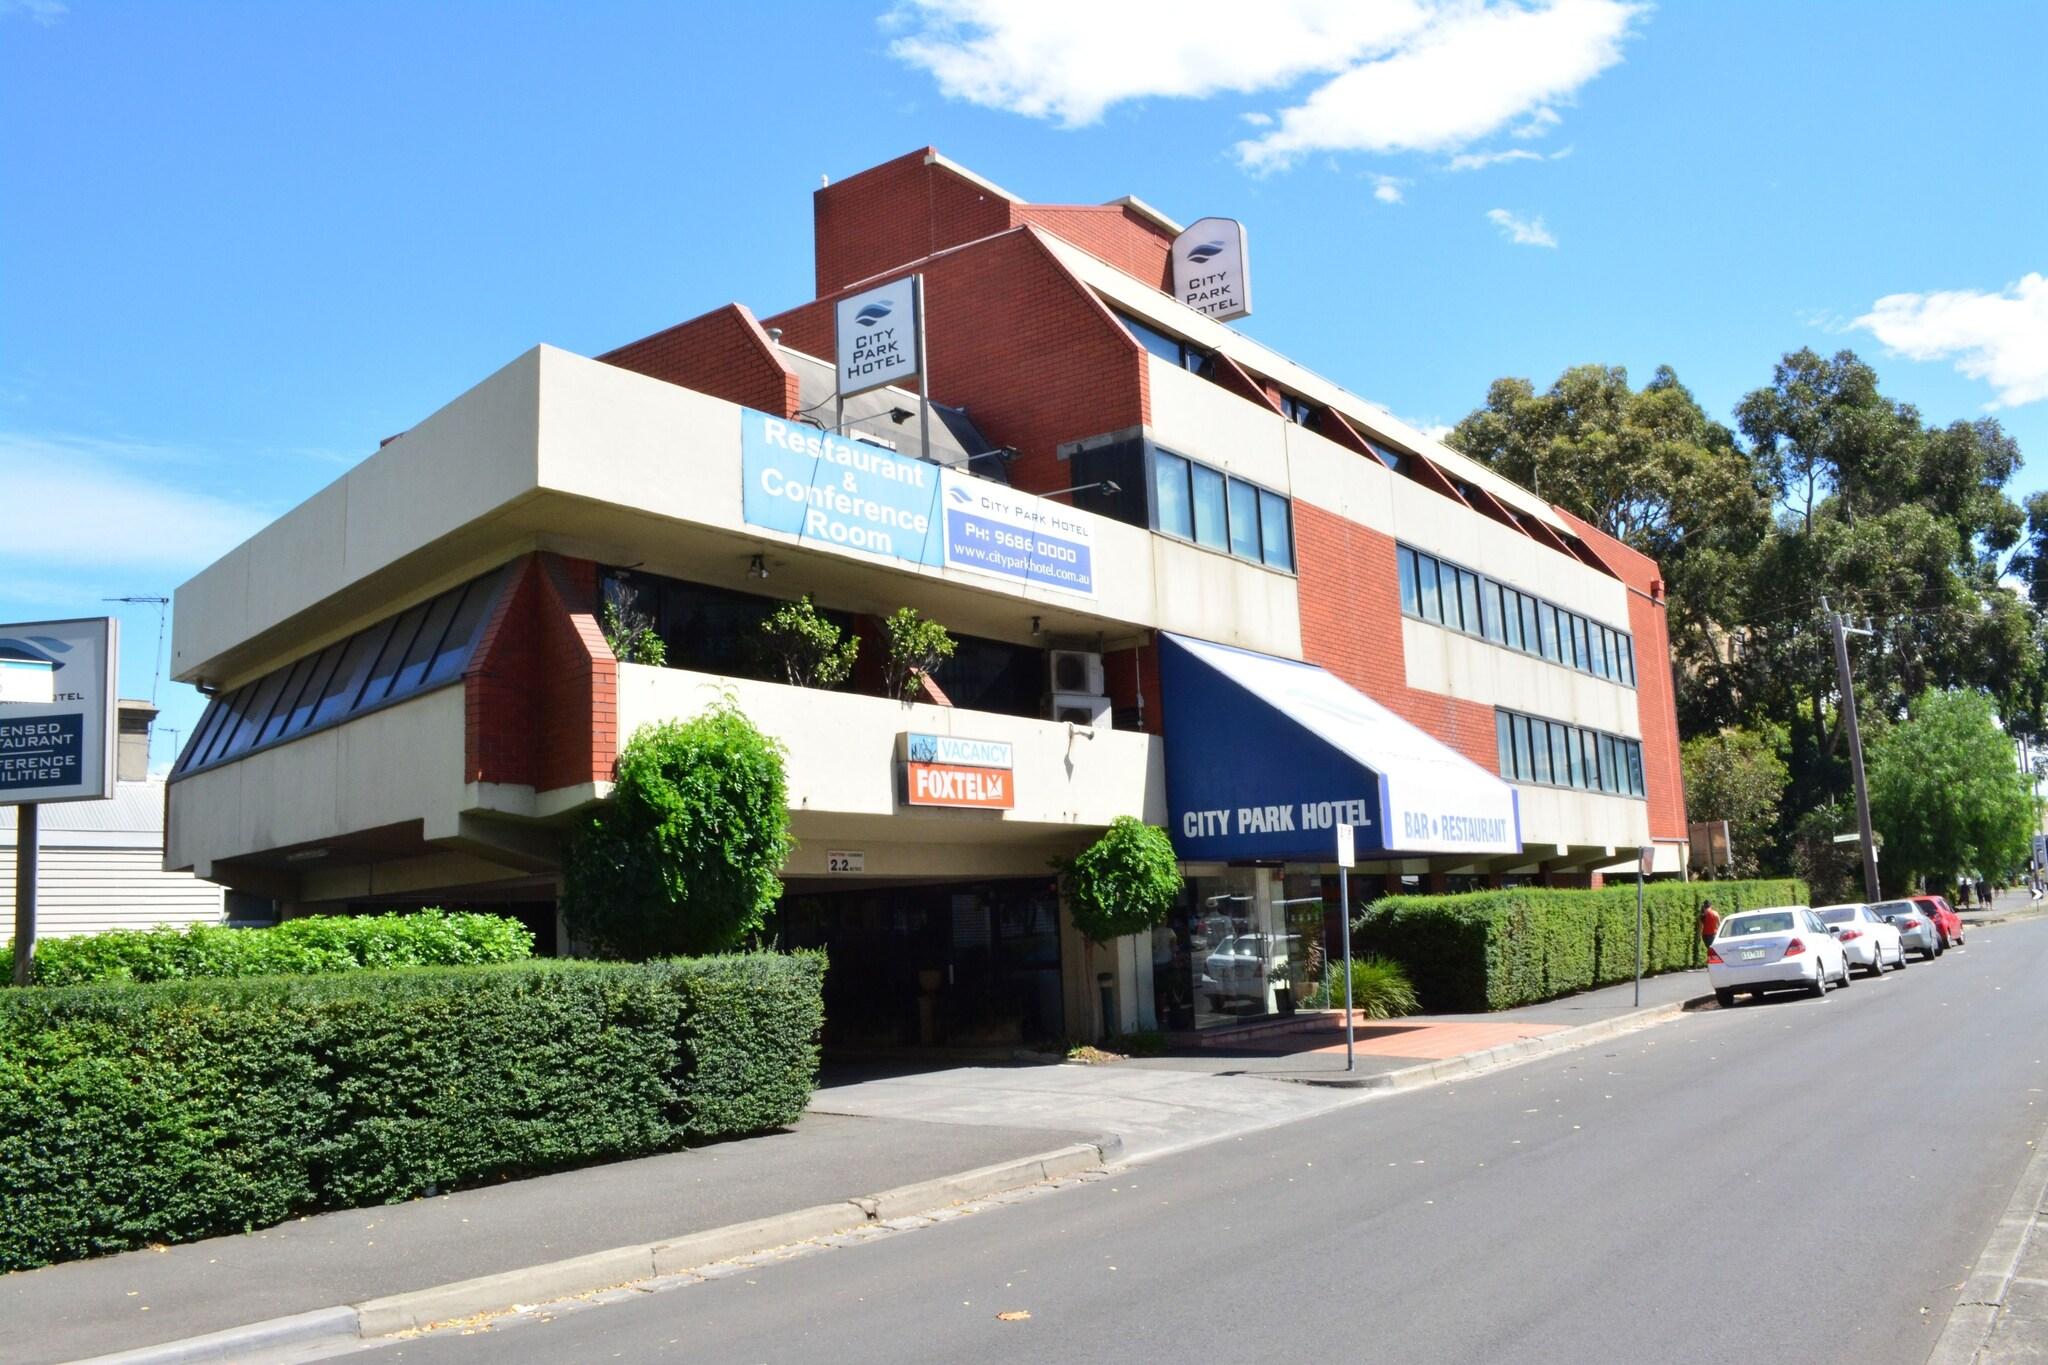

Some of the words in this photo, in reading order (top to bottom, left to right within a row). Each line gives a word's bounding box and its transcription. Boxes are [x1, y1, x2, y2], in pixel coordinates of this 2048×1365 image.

[1189, 271, 1226, 290] CITY
[1186, 284, 1231, 305] PARK
[1197, 298, 1239, 314] TEL
[856, 327, 894, 349] CITY
[853, 340, 898, 364] PARK
[848, 353, 906, 379] HOTEL
[764, 417, 924, 488] Restaurant
[842, 471, 858, 494] &
[760, 467, 928, 534] Conference
[981, 496, 1009, 514] CITY
[1015, 506, 1046, 525] PARK
[1052, 517, 1089, 537] HOTEL
[807, 509, 892, 552] Room
[995, 530, 1034, 552] 9686
[1037, 541, 1077, 563] 0000
[954, 543, 1090, 585] www.cityparkhotel.com.au
[53, 692, 85, 702] TEL
[942, 740, 1008, 763] VACANCY
[2, 768, 61, 782] ILITIES
[916, 768, 987, 801] FOXTEL
[1183, 809, 1231, 838] CITY
[1238, 804, 1295, 835] PARK
[1302, 799, 1371, 830] HOTEL
[1404, 811, 1430, 840] BAR
[1441, 814, 1507, 843] RESTAURANT
[831, 859, 848, 871] 2.2
